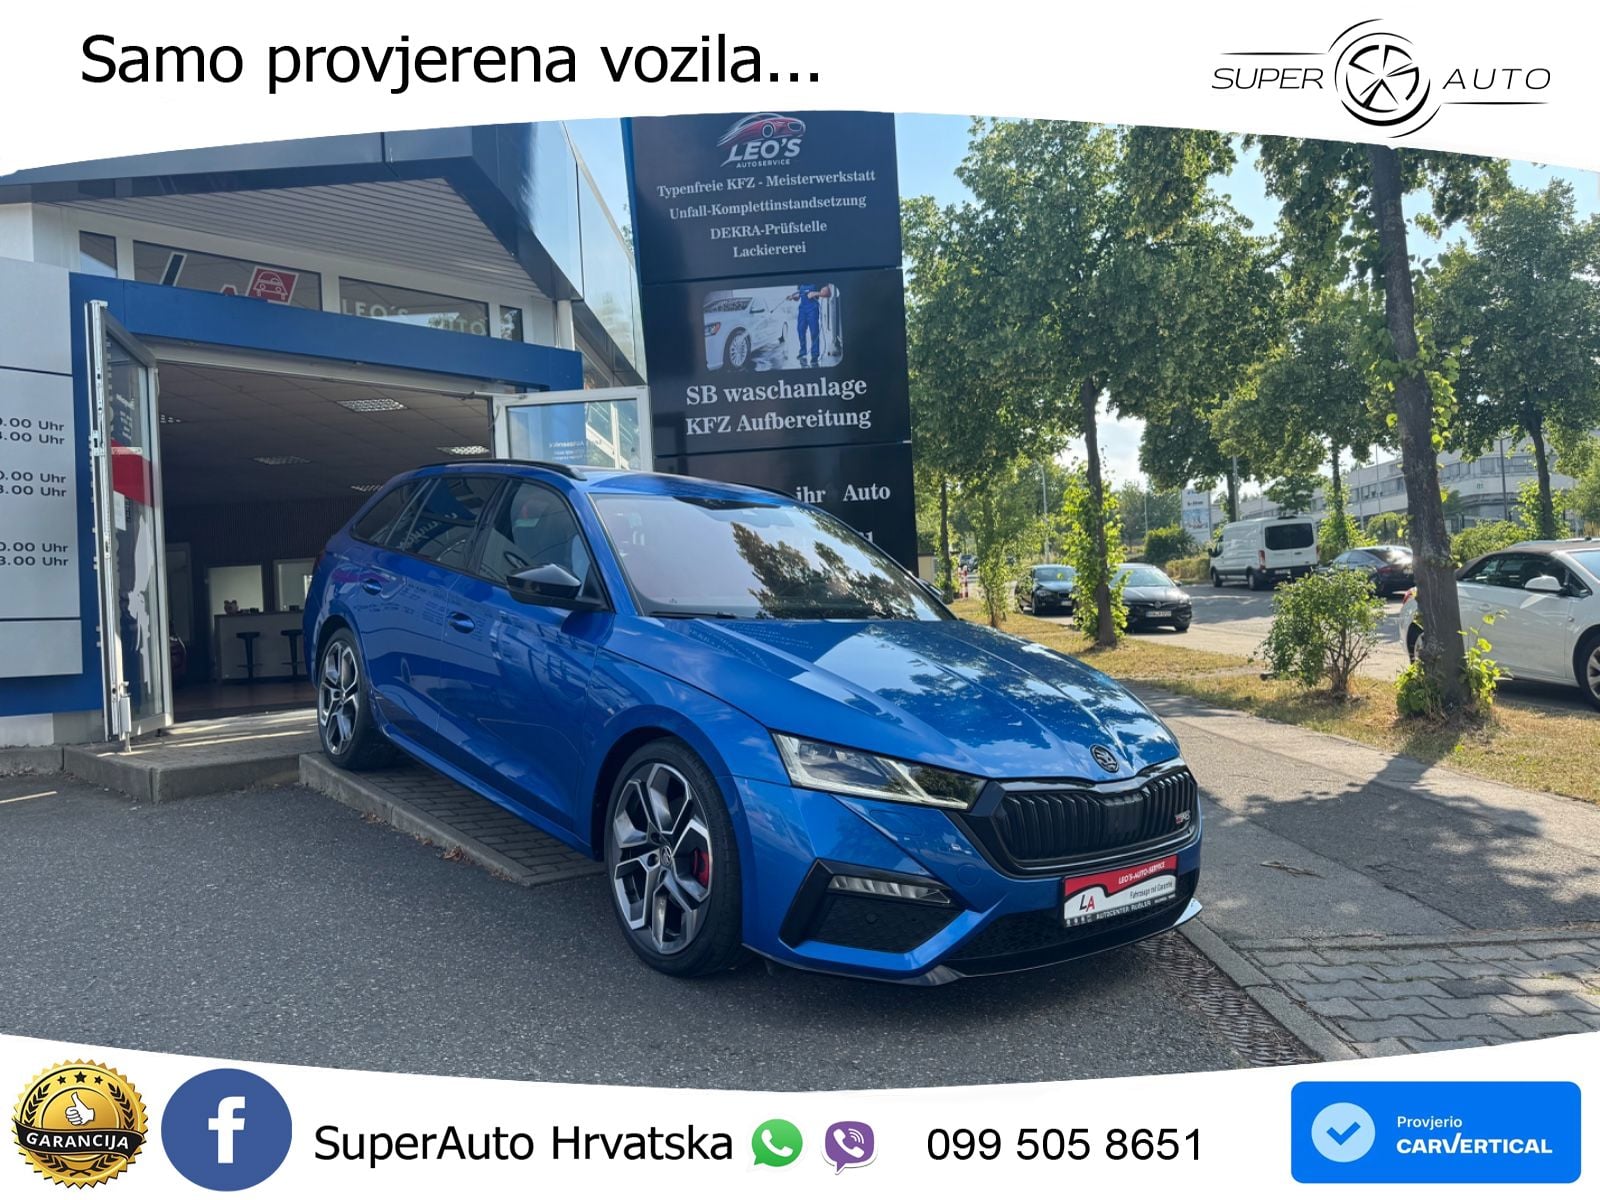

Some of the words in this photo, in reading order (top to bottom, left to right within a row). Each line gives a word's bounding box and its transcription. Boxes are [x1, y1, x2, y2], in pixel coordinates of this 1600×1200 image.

[726, 138, 802, 163] LEO'S
[736, 158, 790, 169] AUTOSERVICE
[657, 179, 724, 198] Typenfreie
[726, 177, 756, 191] KFZ
[766, 169, 876, 188] Meisterwerkstatt
[669, 195, 867, 220] Unfall-Komplettinstandsetzung
[710, 220, 827, 240] DEKRA-Prüfstelle
[733, 241, 807, 258] Lackiererei
[686, 384, 718, 406] SB
[723, 377, 867, 402] waschanlage
[0, 417, 31, 429] .00
[38, 420, 65, 431] Uhr
[686, 415, 731, 435] KFZ
[737, 409, 872, 430] Aufbereitung
[0, 431, 32, 442] .00
[39, 433, 65, 445] Uhr
[40, 472, 67, 483] Uhr
[40, 486, 67, 497] Uhr
[796, 486, 827, 504] ihr
[843, 483, 891, 502] Auto
[42, 543, 69, 552] Uhr
[42, 556, 69, 566] Uhr
